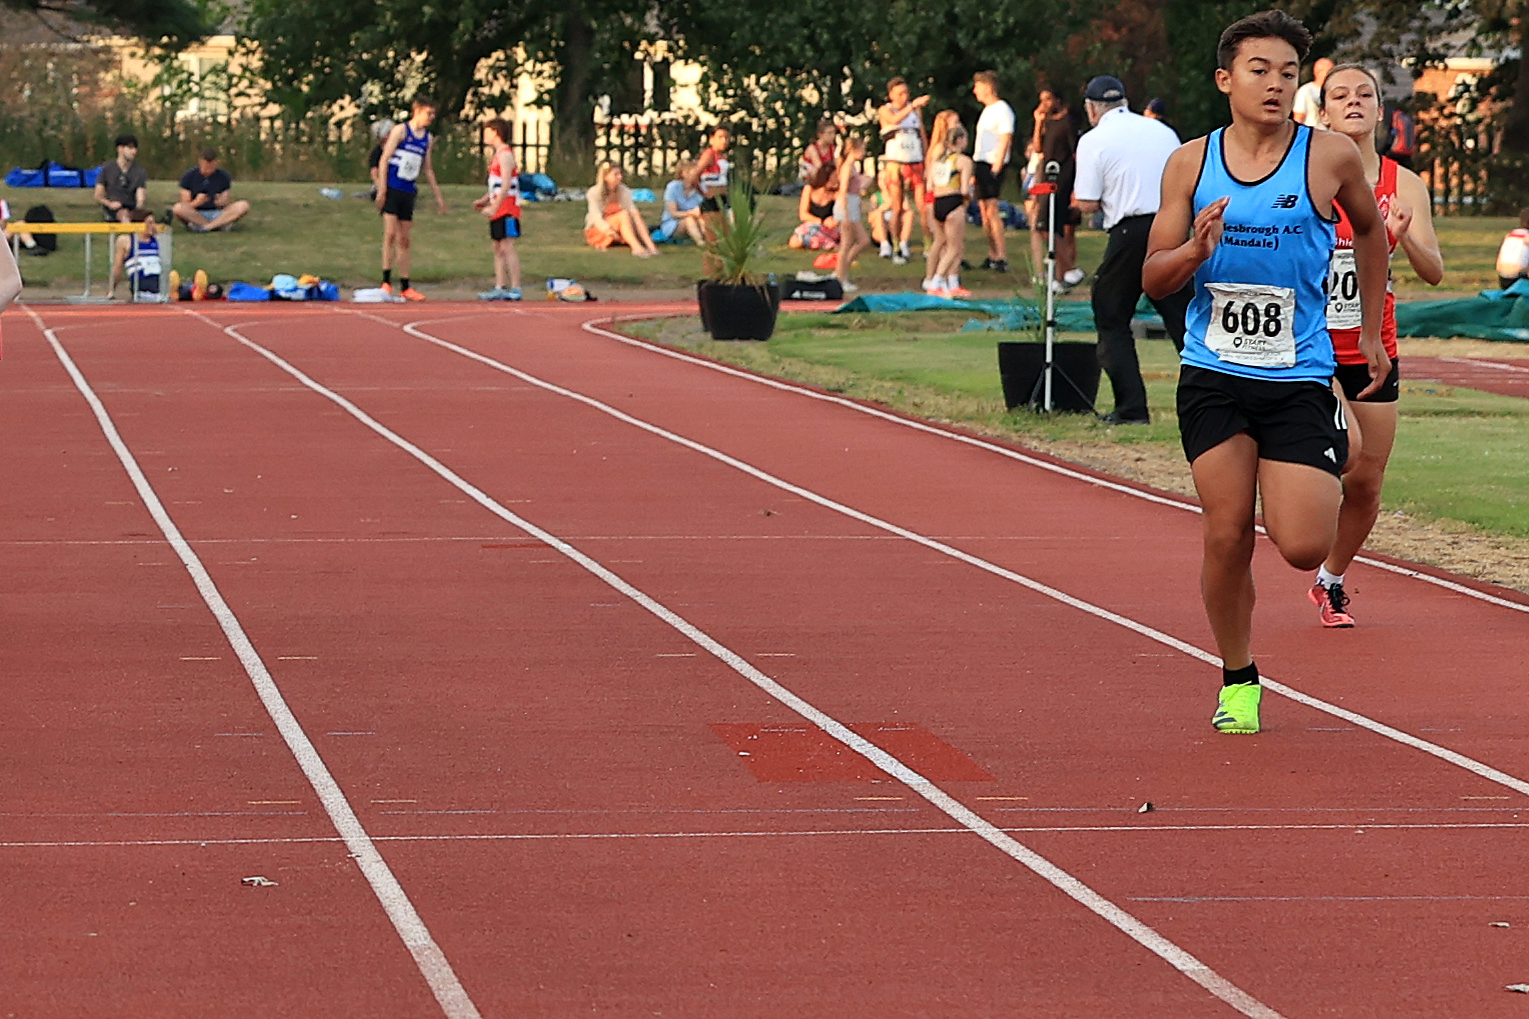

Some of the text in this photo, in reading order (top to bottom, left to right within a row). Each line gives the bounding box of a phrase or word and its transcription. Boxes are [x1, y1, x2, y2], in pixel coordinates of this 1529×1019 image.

[1223, 222, 1279, 236] lesbrough
[1220, 235, 1279, 251] (Mandale)
[1330, 271, 1358, 301] 20
[1222, 301, 1281, 338] 608
